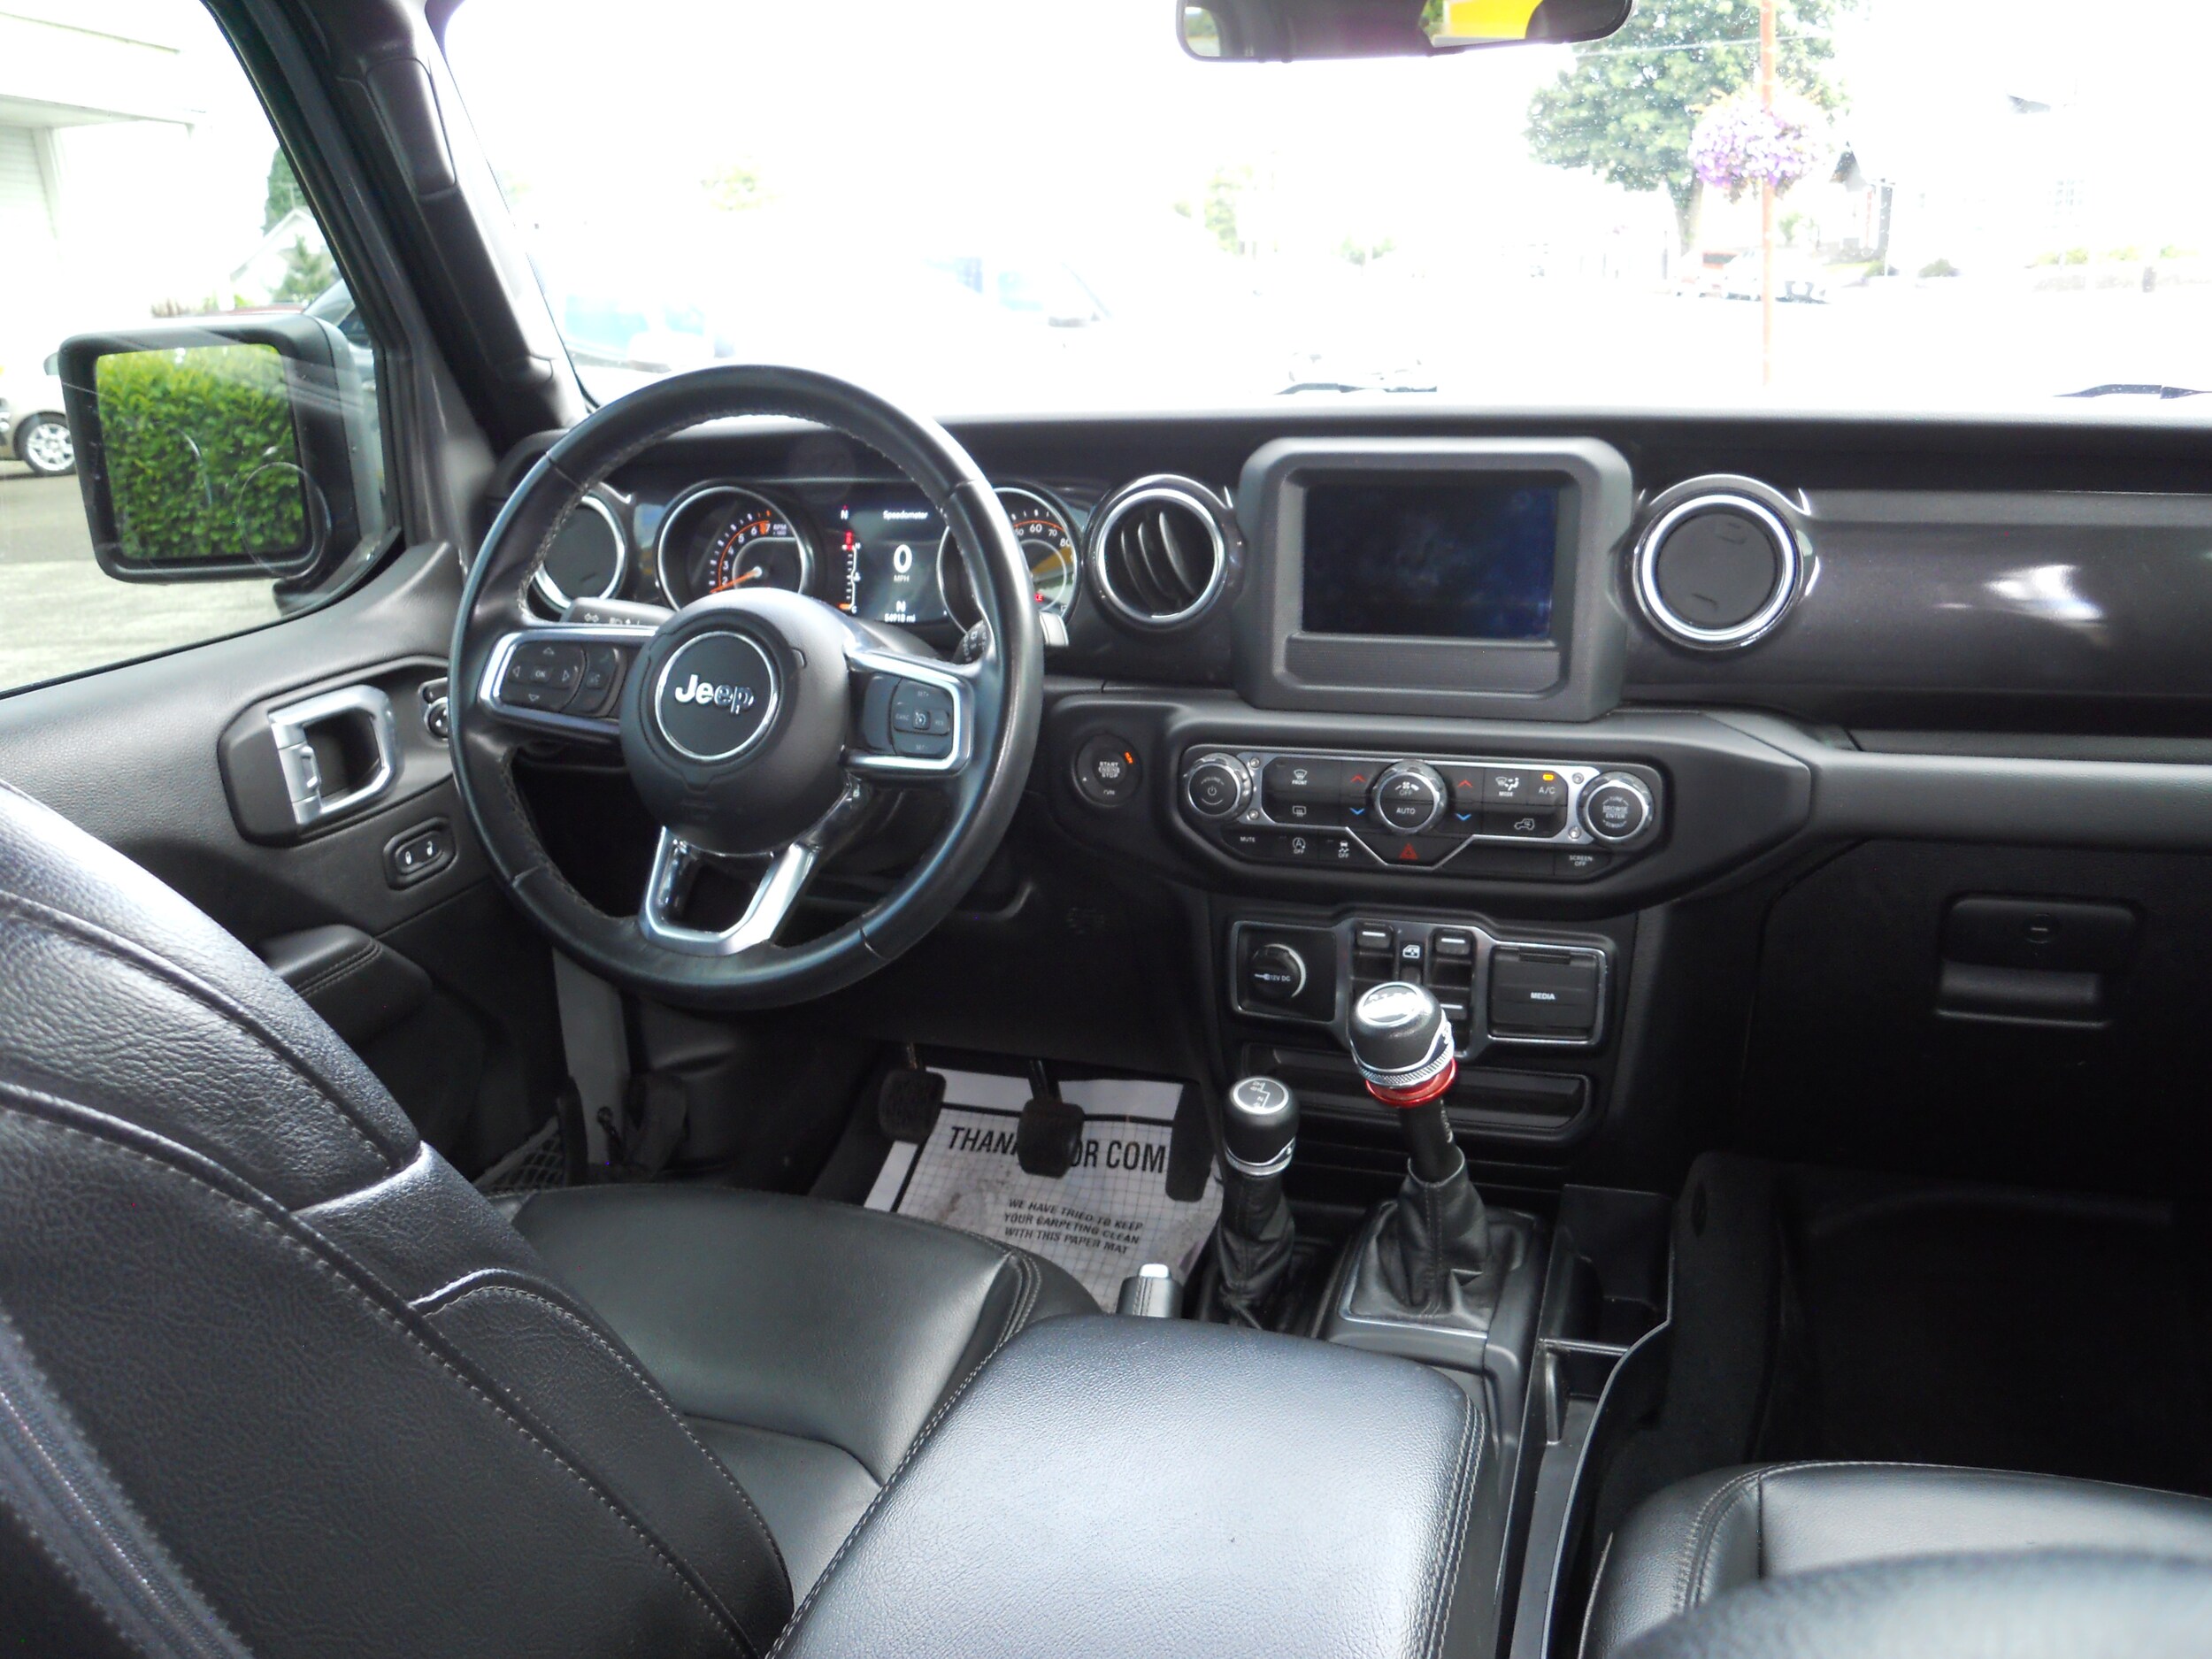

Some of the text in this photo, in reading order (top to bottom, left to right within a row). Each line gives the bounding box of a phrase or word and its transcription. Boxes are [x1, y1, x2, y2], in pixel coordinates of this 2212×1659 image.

[883, 510, 928, 520] Speedometer
[1029, 524, 1042, 533] 60
[894, 544, 912, 573] 0
[896, 601, 906, 612] N
[675, 674, 754, 714] Jeep
[1539, 787, 1555, 795] A/C
[1004, 1212, 1141, 1245] YOUR CARPETING CLEAN
[1009, 1198, 1144, 1232] WE HAVE TRIED TO KEEP
[1004, 1226, 1129, 1255] WITH THIS PAPER MAT
